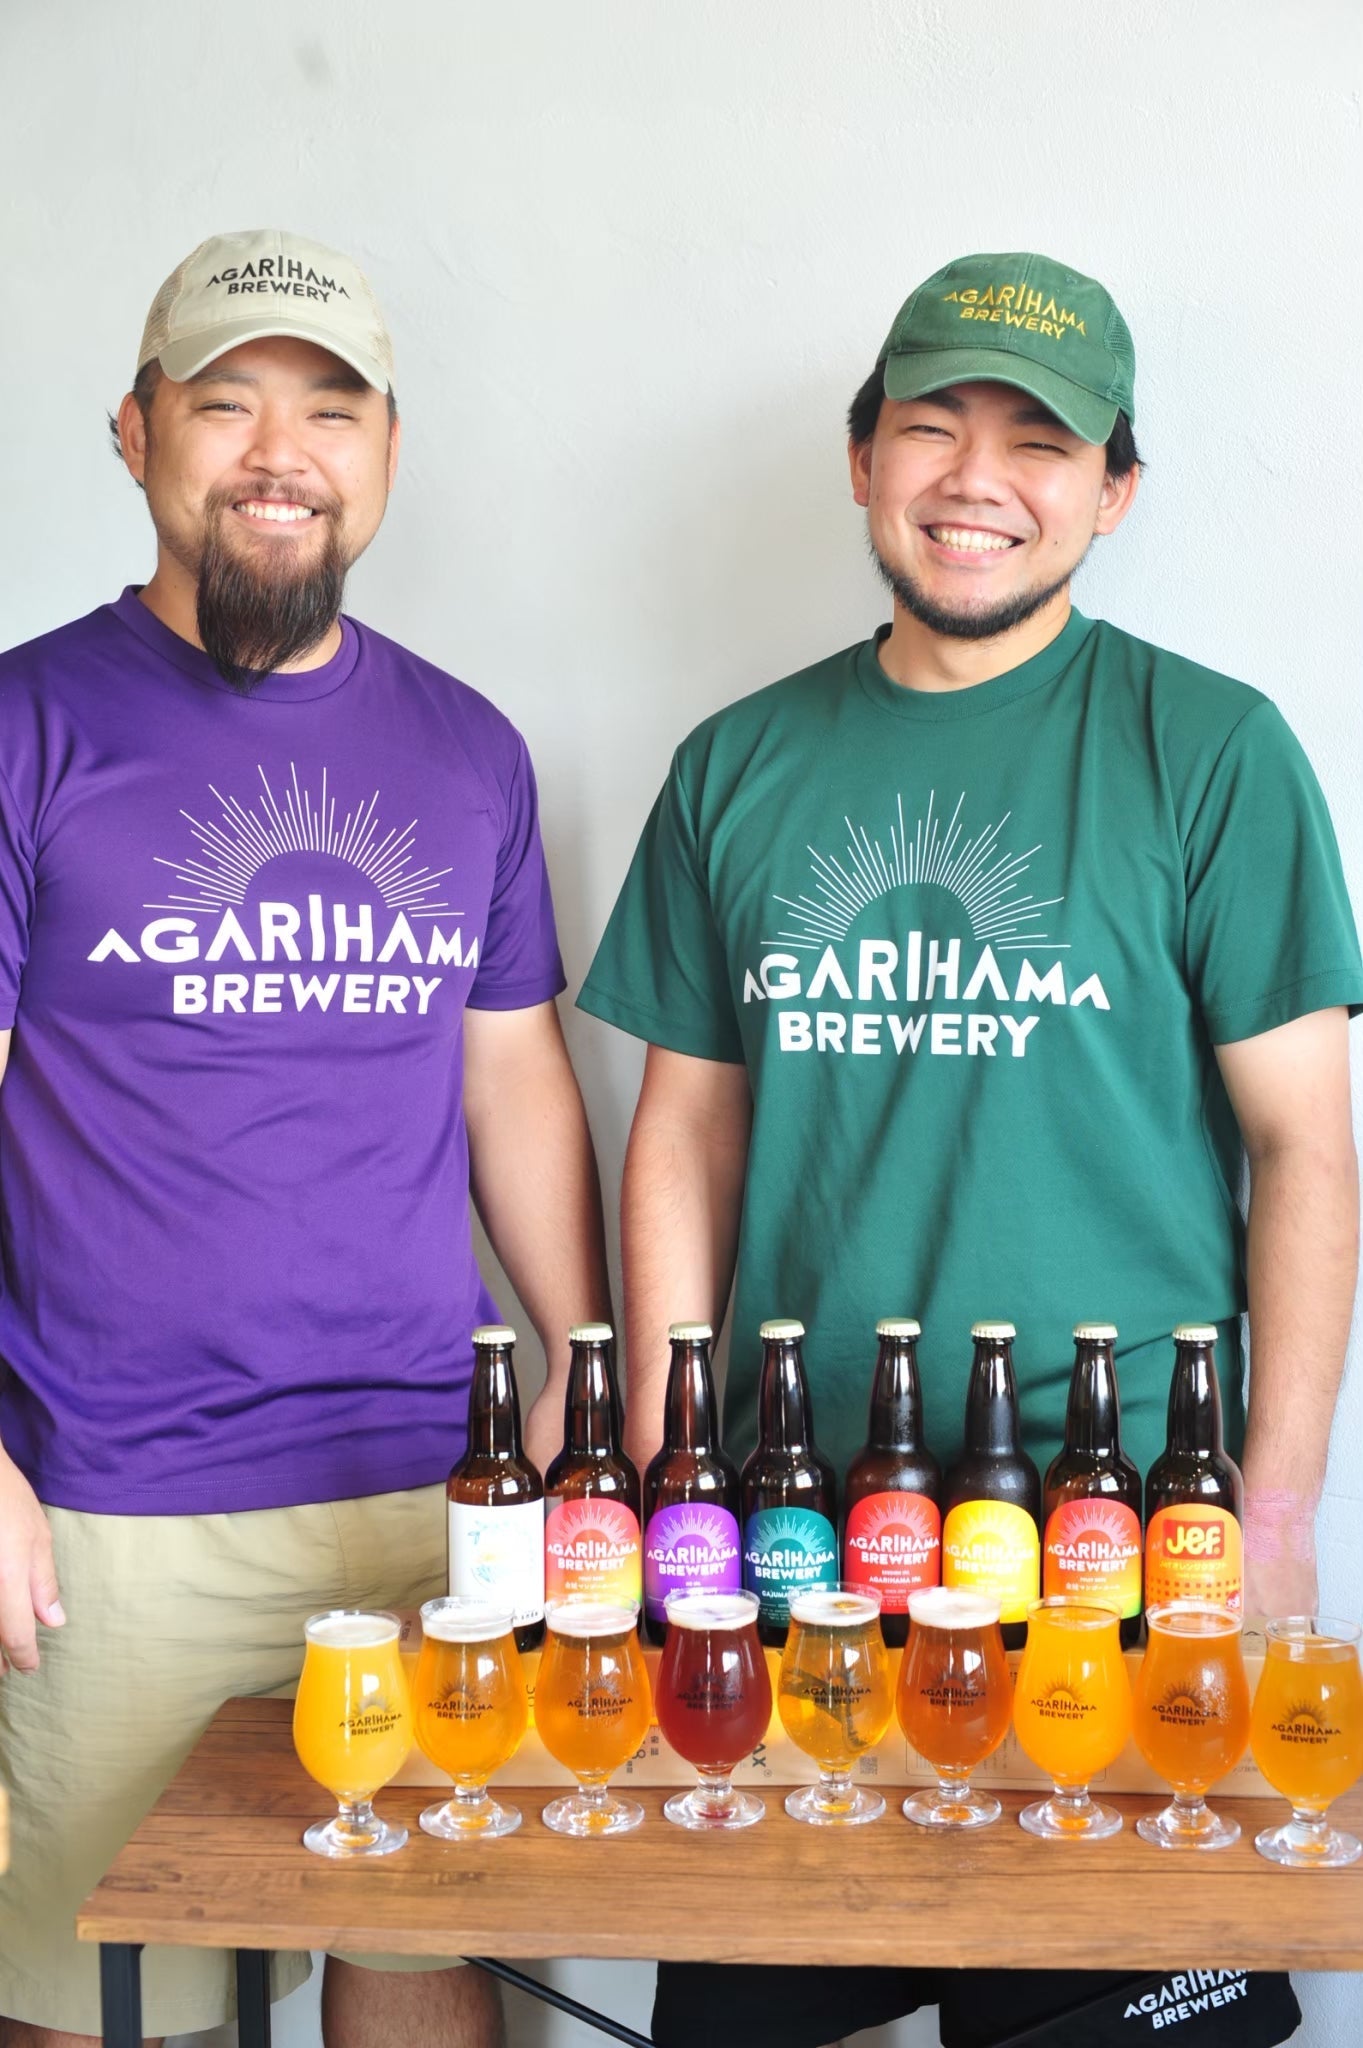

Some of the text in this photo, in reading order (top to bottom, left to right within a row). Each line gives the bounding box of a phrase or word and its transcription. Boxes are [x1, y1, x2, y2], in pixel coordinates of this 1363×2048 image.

[205, 255, 351, 300] AGARIHAMA
[227, 280, 330, 303] BREWERY
[943, 283, 1087, 337] AGARIHAMA
[960, 307, 1066, 341] BREWERY
[743, 931, 1111, 1010] AGARIHAMA
[173, 973, 442, 1015] BREWERY
[778, 1011, 1040, 1058] BREWERY
[547, 1540, 638, 1558] AGARIHAMA
[849, 1534, 940, 1552] AGARIHAMA
[945, 1542, 1035, 1560] AGARIHAMA
[1047, 1541, 1139, 1559] AGARIHAMA
[647, 1545, 738, 1563] AGARIHAMA
[745, 1549, 835, 1568] AGARIHAMA
[861, 1551, 929, 1565] BREWERY
[558, 1557, 625, 1571] BREWERY
[659, 1561, 726, 1576] BREWERY
[755, 1566, 822, 1580] BREWERY
[1059, 1558, 1128, 1572] BREWERY
[920, 1688, 986, 1698] AGARIHAMA
[1031, 1699, 1097, 1711] AGARIHAMA
[339, 1712, 402, 1728] AGARIHAMA
[1039, 1709, 1084, 1720] BREWERY
[1160, 1714, 1207, 1726] BREWERY
[351, 1723, 394, 1736] BREWERY
[1272, 1723, 1341, 1735] AGARIHAMA
[1281, 1734, 1328, 1744] BREWERY
[1151, 1979, 1248, 2030] BREWERY
